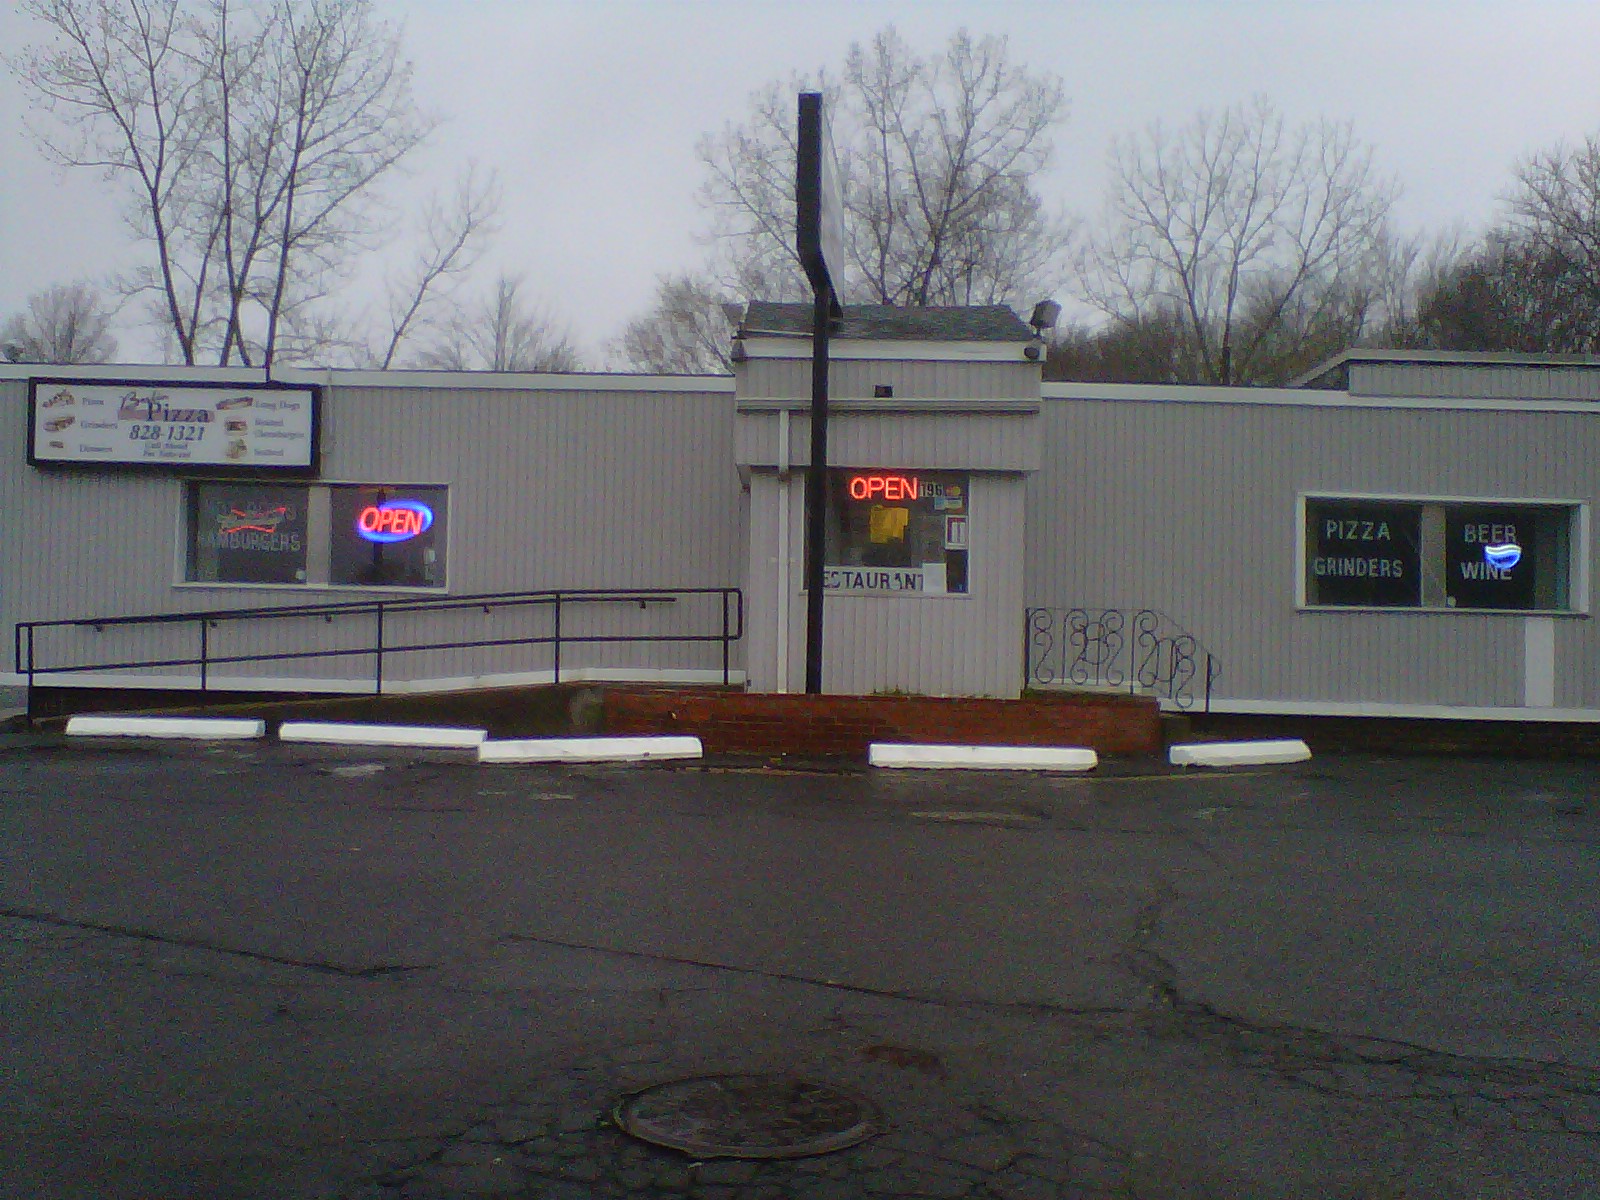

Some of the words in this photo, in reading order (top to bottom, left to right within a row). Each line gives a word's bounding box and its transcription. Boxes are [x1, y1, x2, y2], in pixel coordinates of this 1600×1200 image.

[146, 402, 210, 423] Pizza
[129, 424, 205, 440] 828-1321
[850, 476, 918, 500] OPEN
[359, 506, 423, 535] OPEN
[1326, 519, 1391, 541] PIZZA
[1464, 523, 1517, 543] BEER
[1314, 556, 1403, 579] GRINDERS
[1461, 561, 1512, 580] WINE
